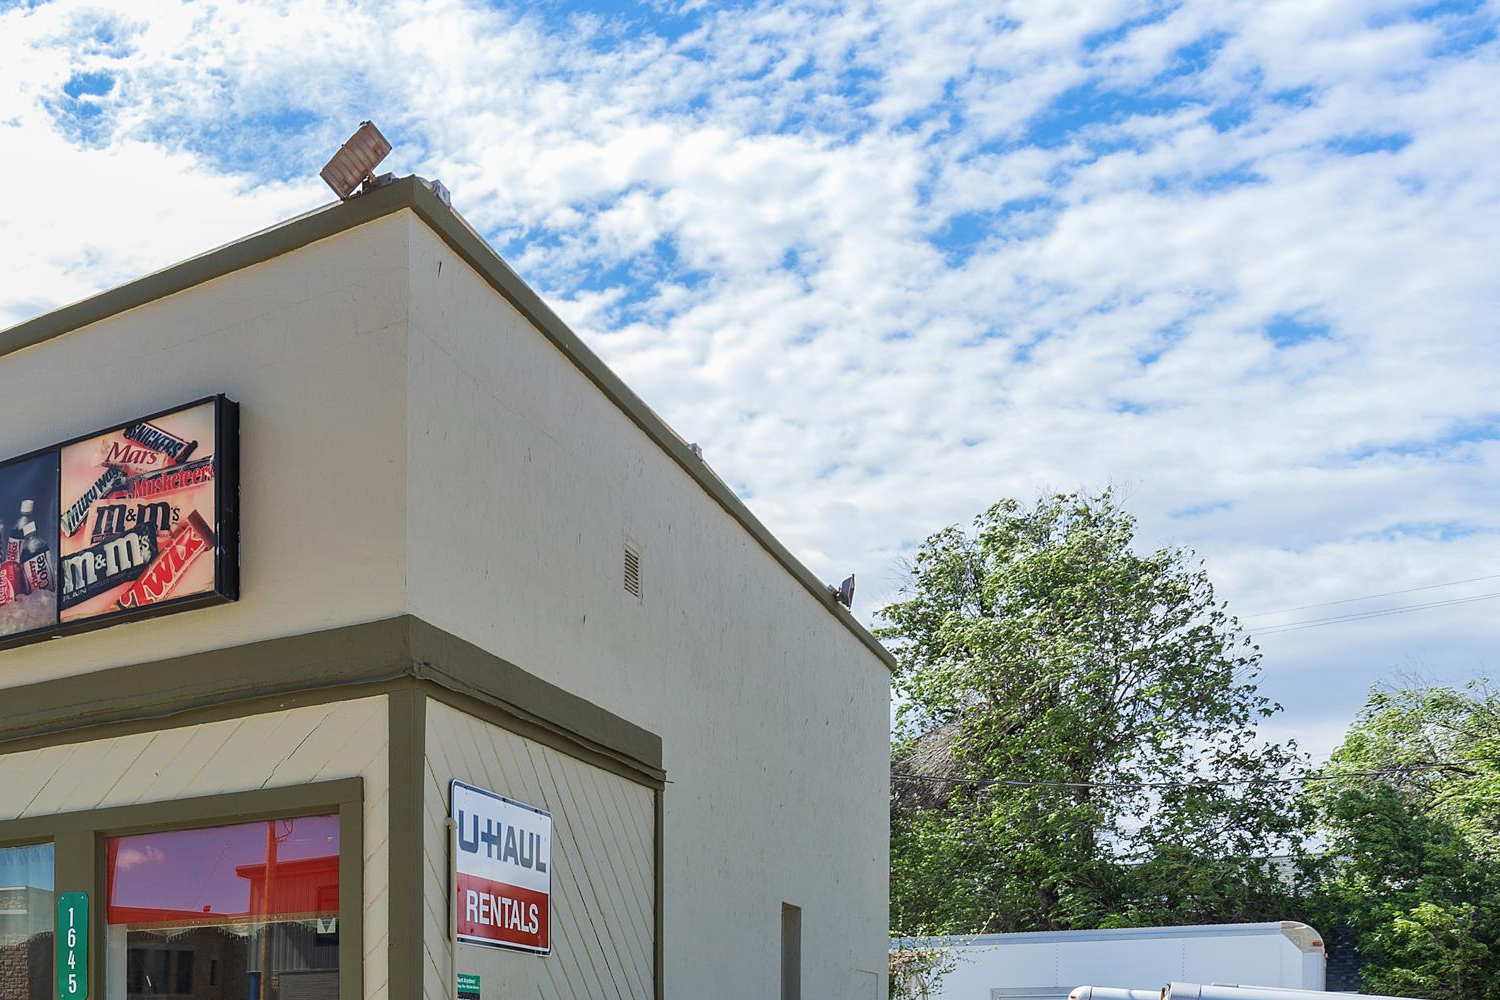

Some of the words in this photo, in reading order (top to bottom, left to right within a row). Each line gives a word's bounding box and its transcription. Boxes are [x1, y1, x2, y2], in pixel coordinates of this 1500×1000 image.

[106, 442, 158, 465] Mars
[131, 423, 185, 458] SNICKERS
[458, 810, 547, 873] U-HAUL
[466, 890, 539, 935] RENTALS
